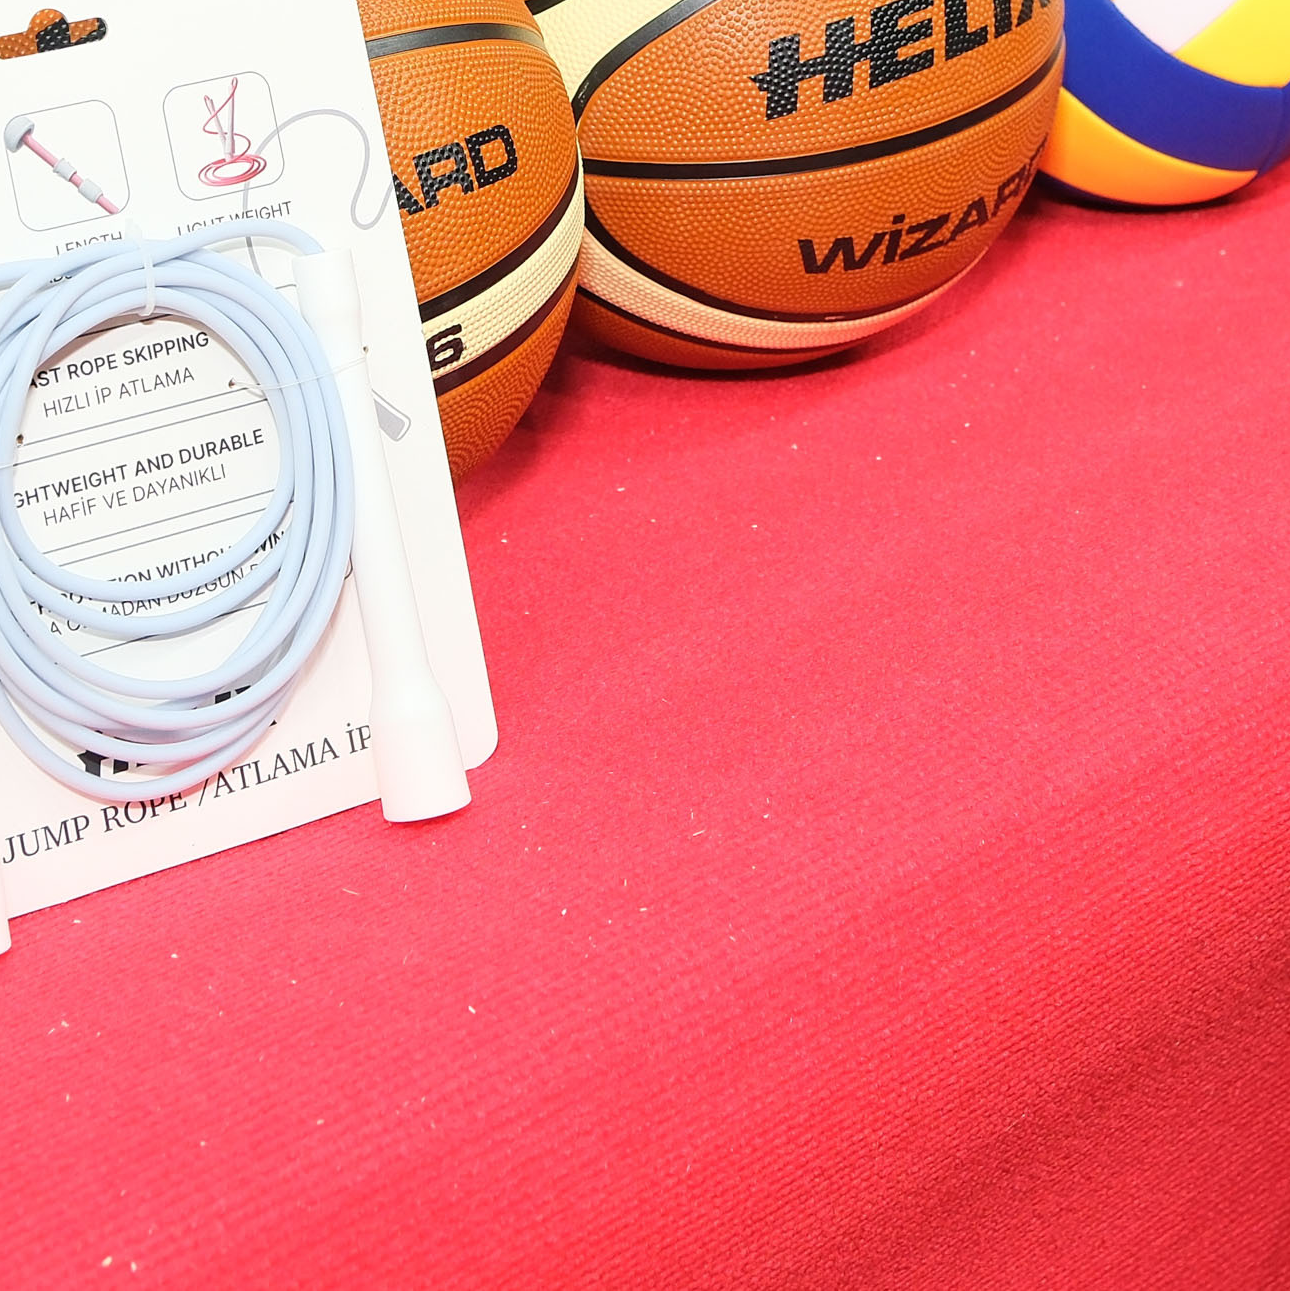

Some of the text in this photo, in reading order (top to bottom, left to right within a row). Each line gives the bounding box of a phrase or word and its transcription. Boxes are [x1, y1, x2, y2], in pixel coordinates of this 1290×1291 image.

[29, 331, 210, 390] AST ROPE SKIPPING
[42, 366, 195, 418] HIZLI İP ATLAMA
[13, 428, 265, 509] GHTWEIGHT AND DURABLE
[43, 463, 227, 527] HAFİF VE DAYANIKLI
[1, 814, 91, 865] JUMP
[100, 792, 188, 833] ROPE
